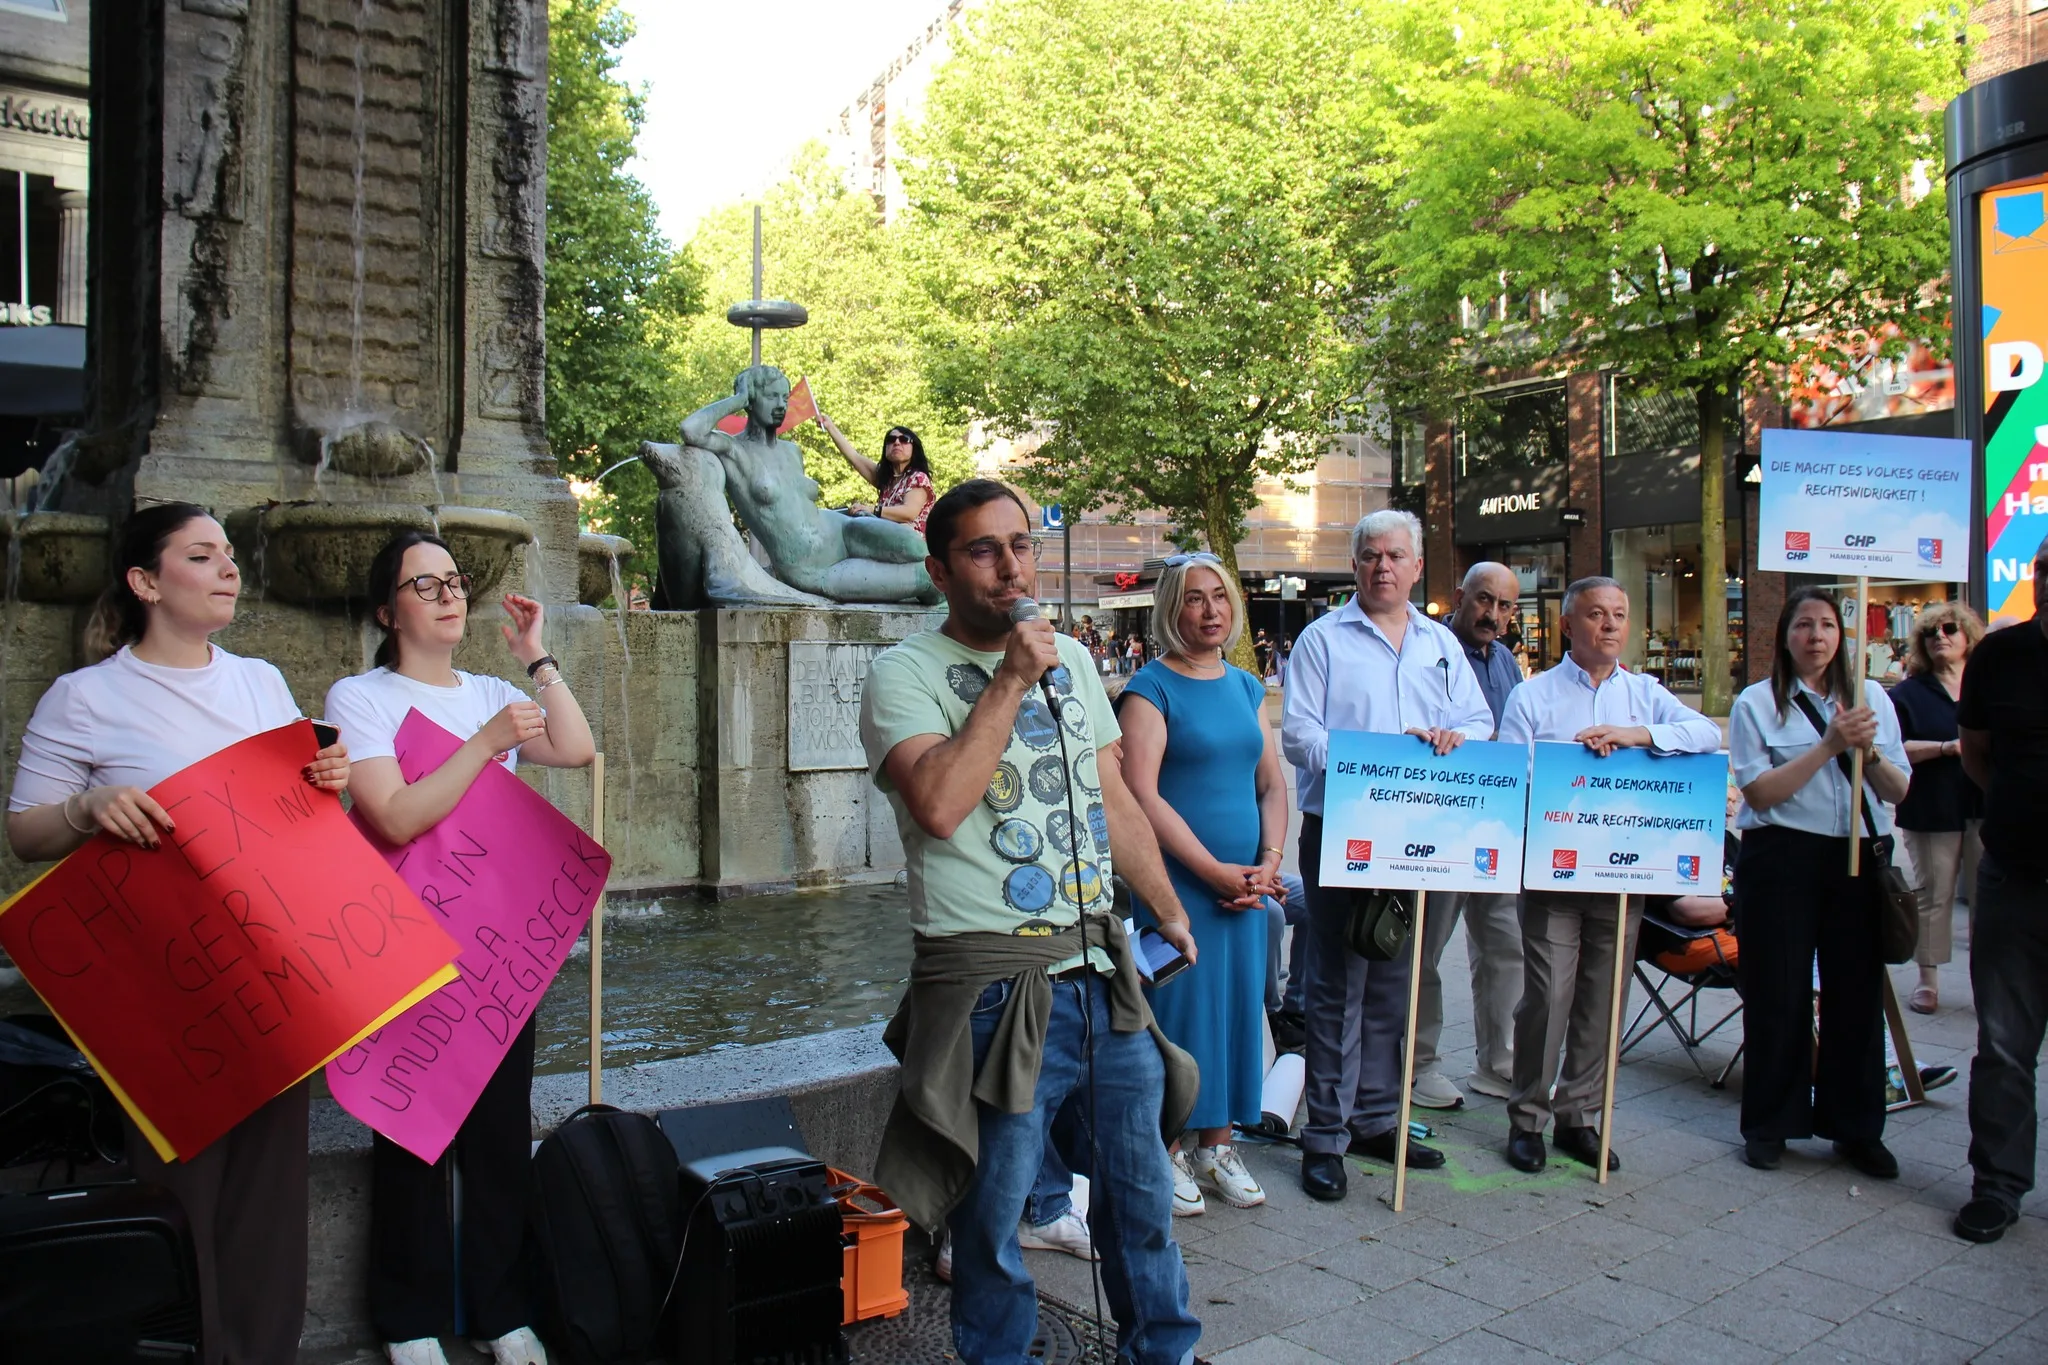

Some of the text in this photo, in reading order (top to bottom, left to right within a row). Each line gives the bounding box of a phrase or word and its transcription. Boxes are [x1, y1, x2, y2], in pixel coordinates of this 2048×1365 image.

[3, 95, 90, 140] Kultu
[1771, 461, 1960, 482] DIE MACHT DES VOLKES GEGEN
[1805, 483, 1917, 501] RECHTSWIDRIGKEIT
[2004, 491, 2048, 516] Ha
[1844, 534, 1876, 547] CHP
[1786, 552, 1808, 561] CHP
[1829, 553, 1866, 561] HAMBURG
[1992, 558, 2035, 582] Nu
[804, 705, 860, 727] JOHAN
[1337, 761, 1518, 788] DIE MACHT DES VOLKES GEGEN
[1571, 775, 1586, 789] JA
[1590, 776, 1612, 791] ZUR
[1614, 778, 1685, 794] DEMOKRATIE
[1369, 788, 1478, 809] RECHTSWIDRIGKEIT
[1544, 811, 1574, 824] NEIN
[1577, 812, 1599, 827] ZUR
[1602, 814, 1706, 832] RECHTSWIDRIGKEIT
[1404, 843, 1436, 858] CHP
[1609, 852, 1639, 866] CHP
[1347, 861, 1369, 872] CHP
[1389, 864, 1424, 873] HAMBURG
[1553, 870, 1574, 880] CHP
[1594, 871, 1628, 880] HAMBURG
[28, 849, 142, 978] CHP
